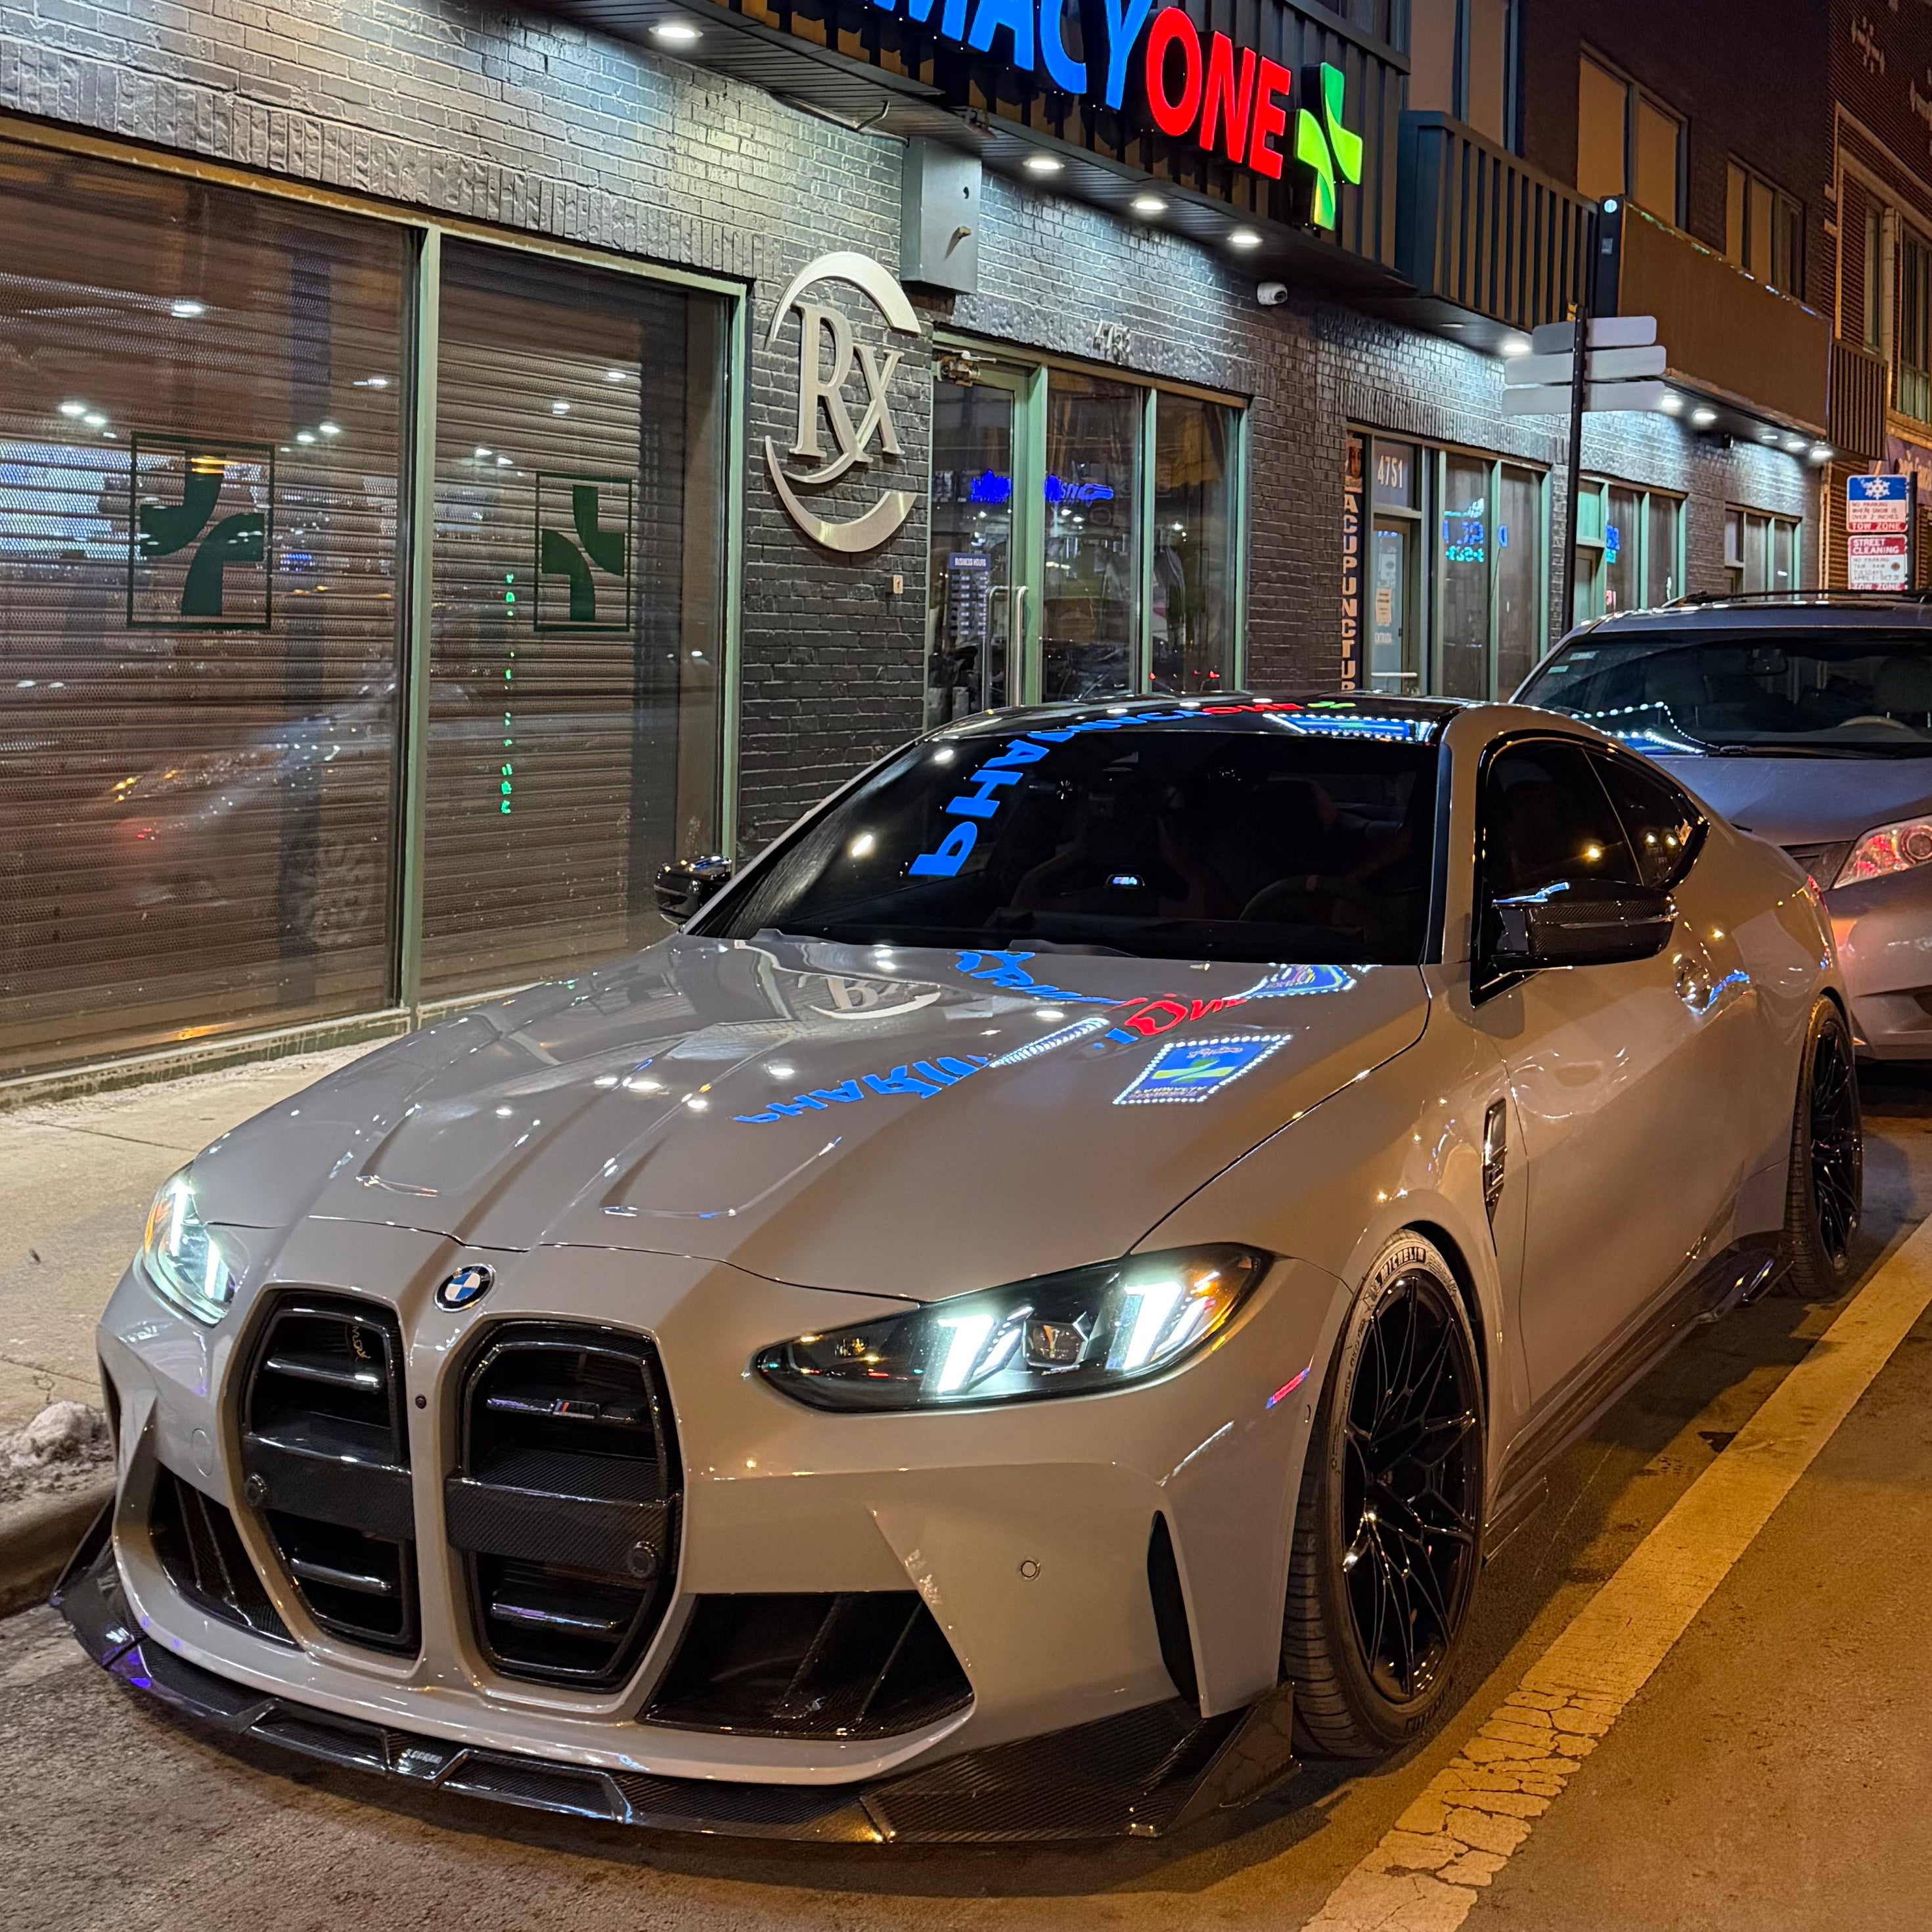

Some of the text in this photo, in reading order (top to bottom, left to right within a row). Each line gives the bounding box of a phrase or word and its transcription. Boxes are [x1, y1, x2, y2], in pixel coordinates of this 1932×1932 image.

[1146, 6, 1292, 181] ONE
[1377, 455, 1403, 489] 4751
[1853, 538, 1885, 547] STREET
[1853, 546, 1900, 554] CLEANING
[1380, 1246, 1426, 1278] MICHELIN
